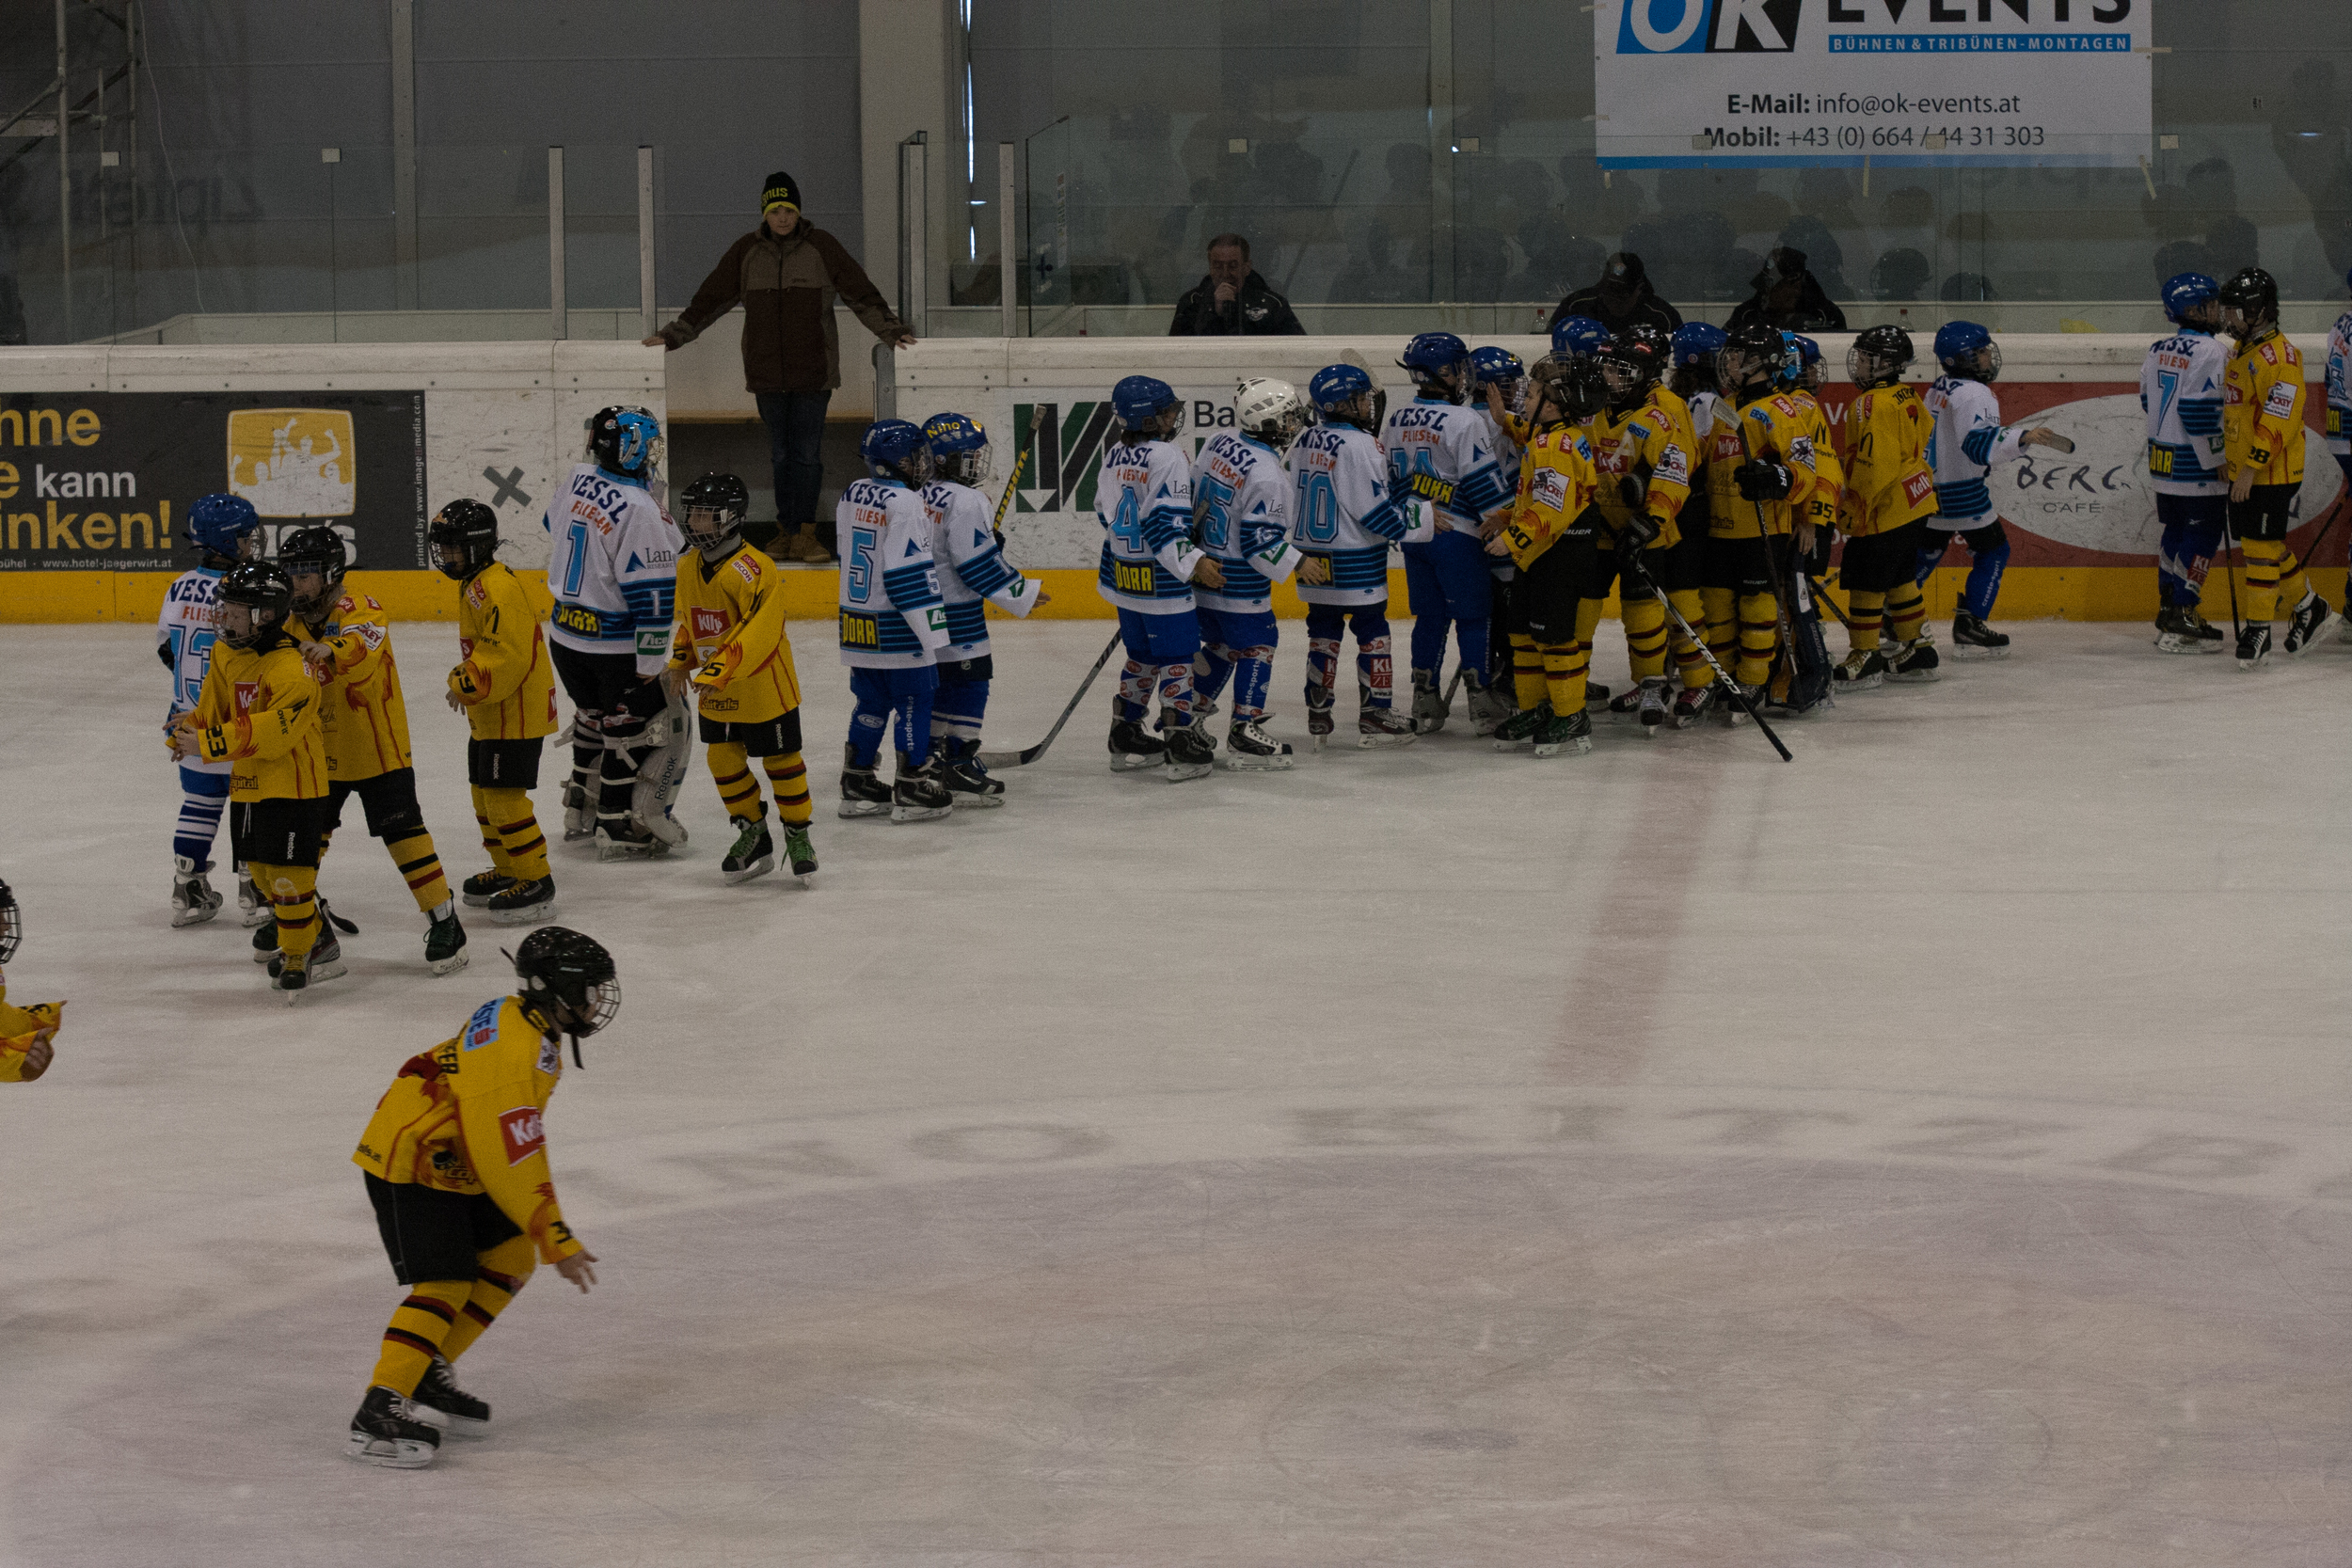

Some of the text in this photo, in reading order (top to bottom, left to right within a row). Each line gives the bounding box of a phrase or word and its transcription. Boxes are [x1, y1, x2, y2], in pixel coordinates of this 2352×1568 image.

[1629, 0, 1789, 52] OK
[1833, 36, 2127, 51] BÜHNEN & TRIBÜNEN-MONTAGEN
[1727, 92, 2021, 116] E-Mail: info@ok-events.at
[1704, 127, 1780, 147] Mobil:
[1786, 128, 1829, 147] +43
[1837, 126, 1865, 150] (0)
[1872, 127, 1914, 147] 664
[1970, 127, 1994, 146] 31
[2004, 127, 2044, 147] 303
[1775, 397, 1795, 416] Kelly's
[2157, 370, 2179, 436] 7
[927, 421, 961, 438] Nino
[36, 464, 136, 499] kann
[1111, 484, 1145, 553] 4
[1294, 468, 1340, 544] 10
[1809, 500, 1835, 519] 35
[0, 500, 172, 550] nken!
[1507, 524, 1533, 550] 80
[416, 533, 426, 566] printed
[563, 520, 591, 597] 1
[848, 526, 877, 604] 5
[733, 561, 754, 583] RICOH
[650, 589, 661, 617] 1
[205, 724, 228, 758] 23
[655, 757, 677, 800] Reebok
